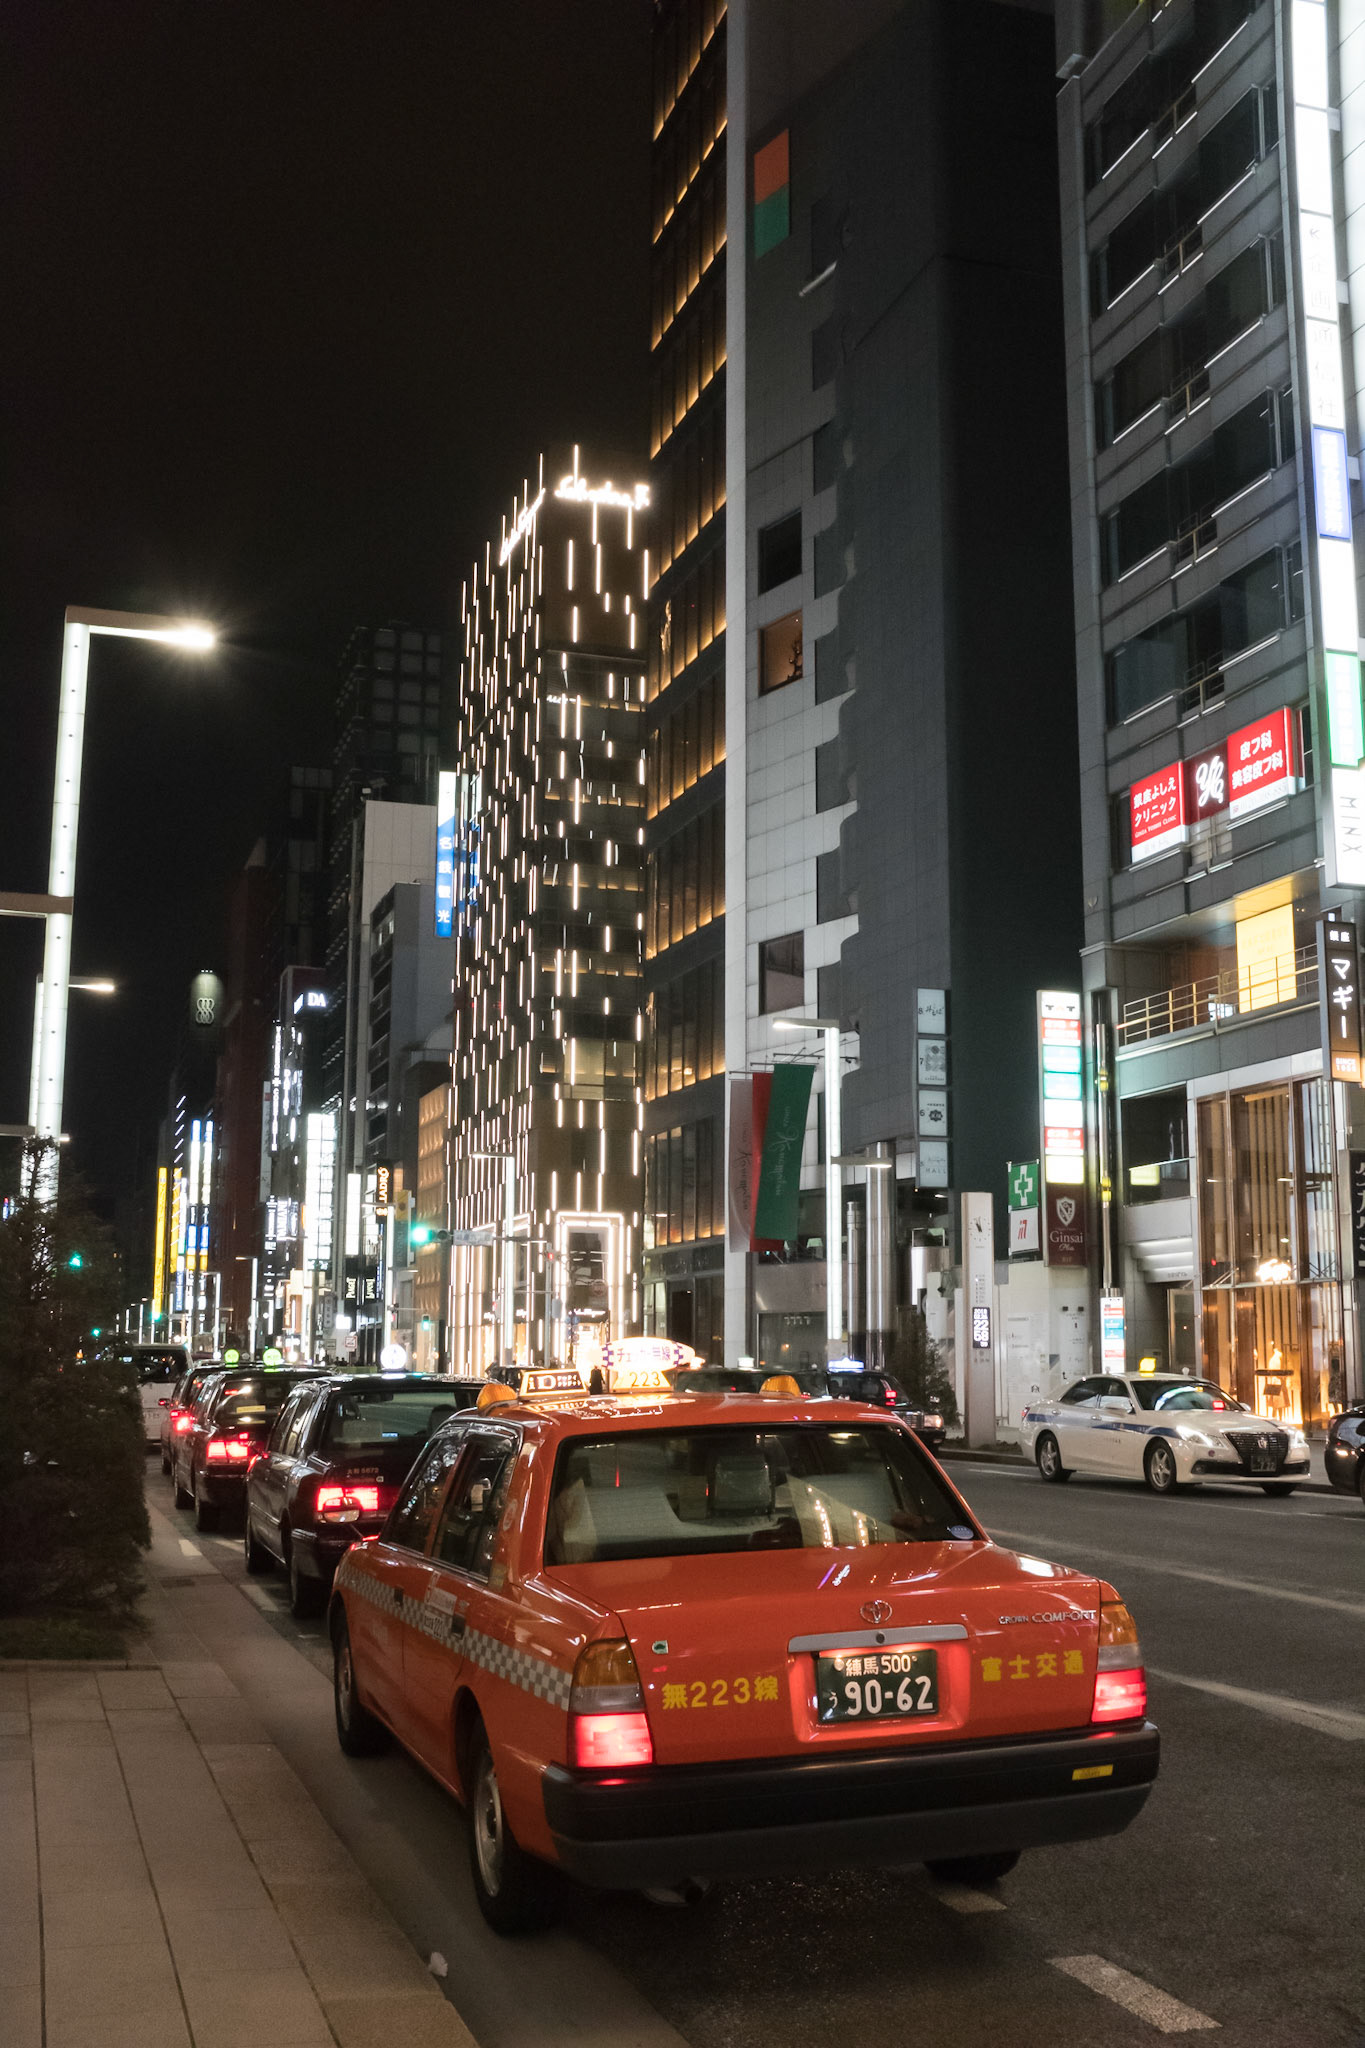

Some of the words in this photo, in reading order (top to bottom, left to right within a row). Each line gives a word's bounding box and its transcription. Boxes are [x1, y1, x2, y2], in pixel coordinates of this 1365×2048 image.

[1239, 729, 1273, 761] 皮フ科
[1231, 749, 1284, 791] 美容皮フ科
[1132, 776, 1177, 810] 銀座よしえ
[1133, 795, 1177, 828] クリニック
[1339, 796, 1362, 854] MINX
[1329, 930, 1351, 943] 銀座
[1331, 958, 1354, 1038] マギー
[1050, 1230, 1083, 1243] Ginsai
[973, 1319, 988, 1330] 22
[973, 1330, 988, 1341] 58
[630, 1372, 661, 1387] 223
[999, 1615, 1028, 1624] CROWN
[1032, 1610, 1096, 1623] COMFORT
[846, 1658, 879, 1676] 練馬
[881, 1655, 911, 1674] 500
[981, 1650, 1083, 1682] 富士交通
[662, 1676, 778, 1709] 無223線
[828, 1691, 838, 1709] う
[845, 1676, 934, 1716] 90-62
